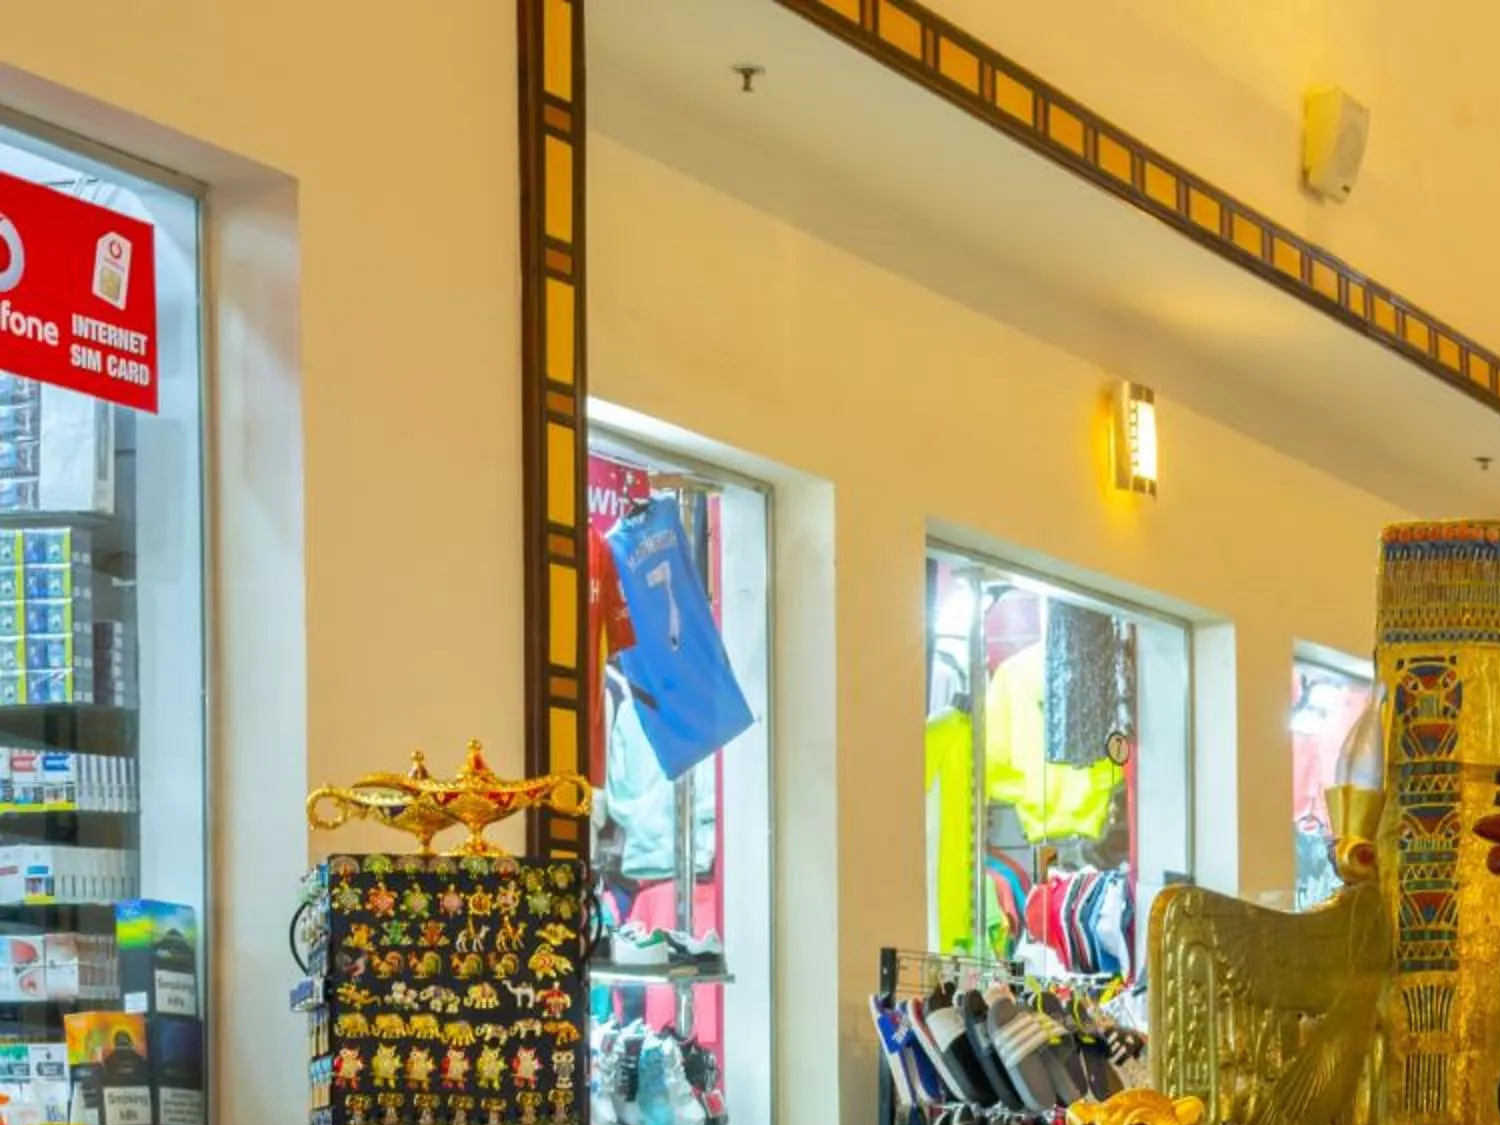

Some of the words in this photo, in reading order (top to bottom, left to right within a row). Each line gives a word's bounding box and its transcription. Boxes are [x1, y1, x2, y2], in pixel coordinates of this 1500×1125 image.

[71, 313, 149, 356] INTERNET
[69, 344, 102, 374] SIM
[106, 355, 150, 387] CARD
